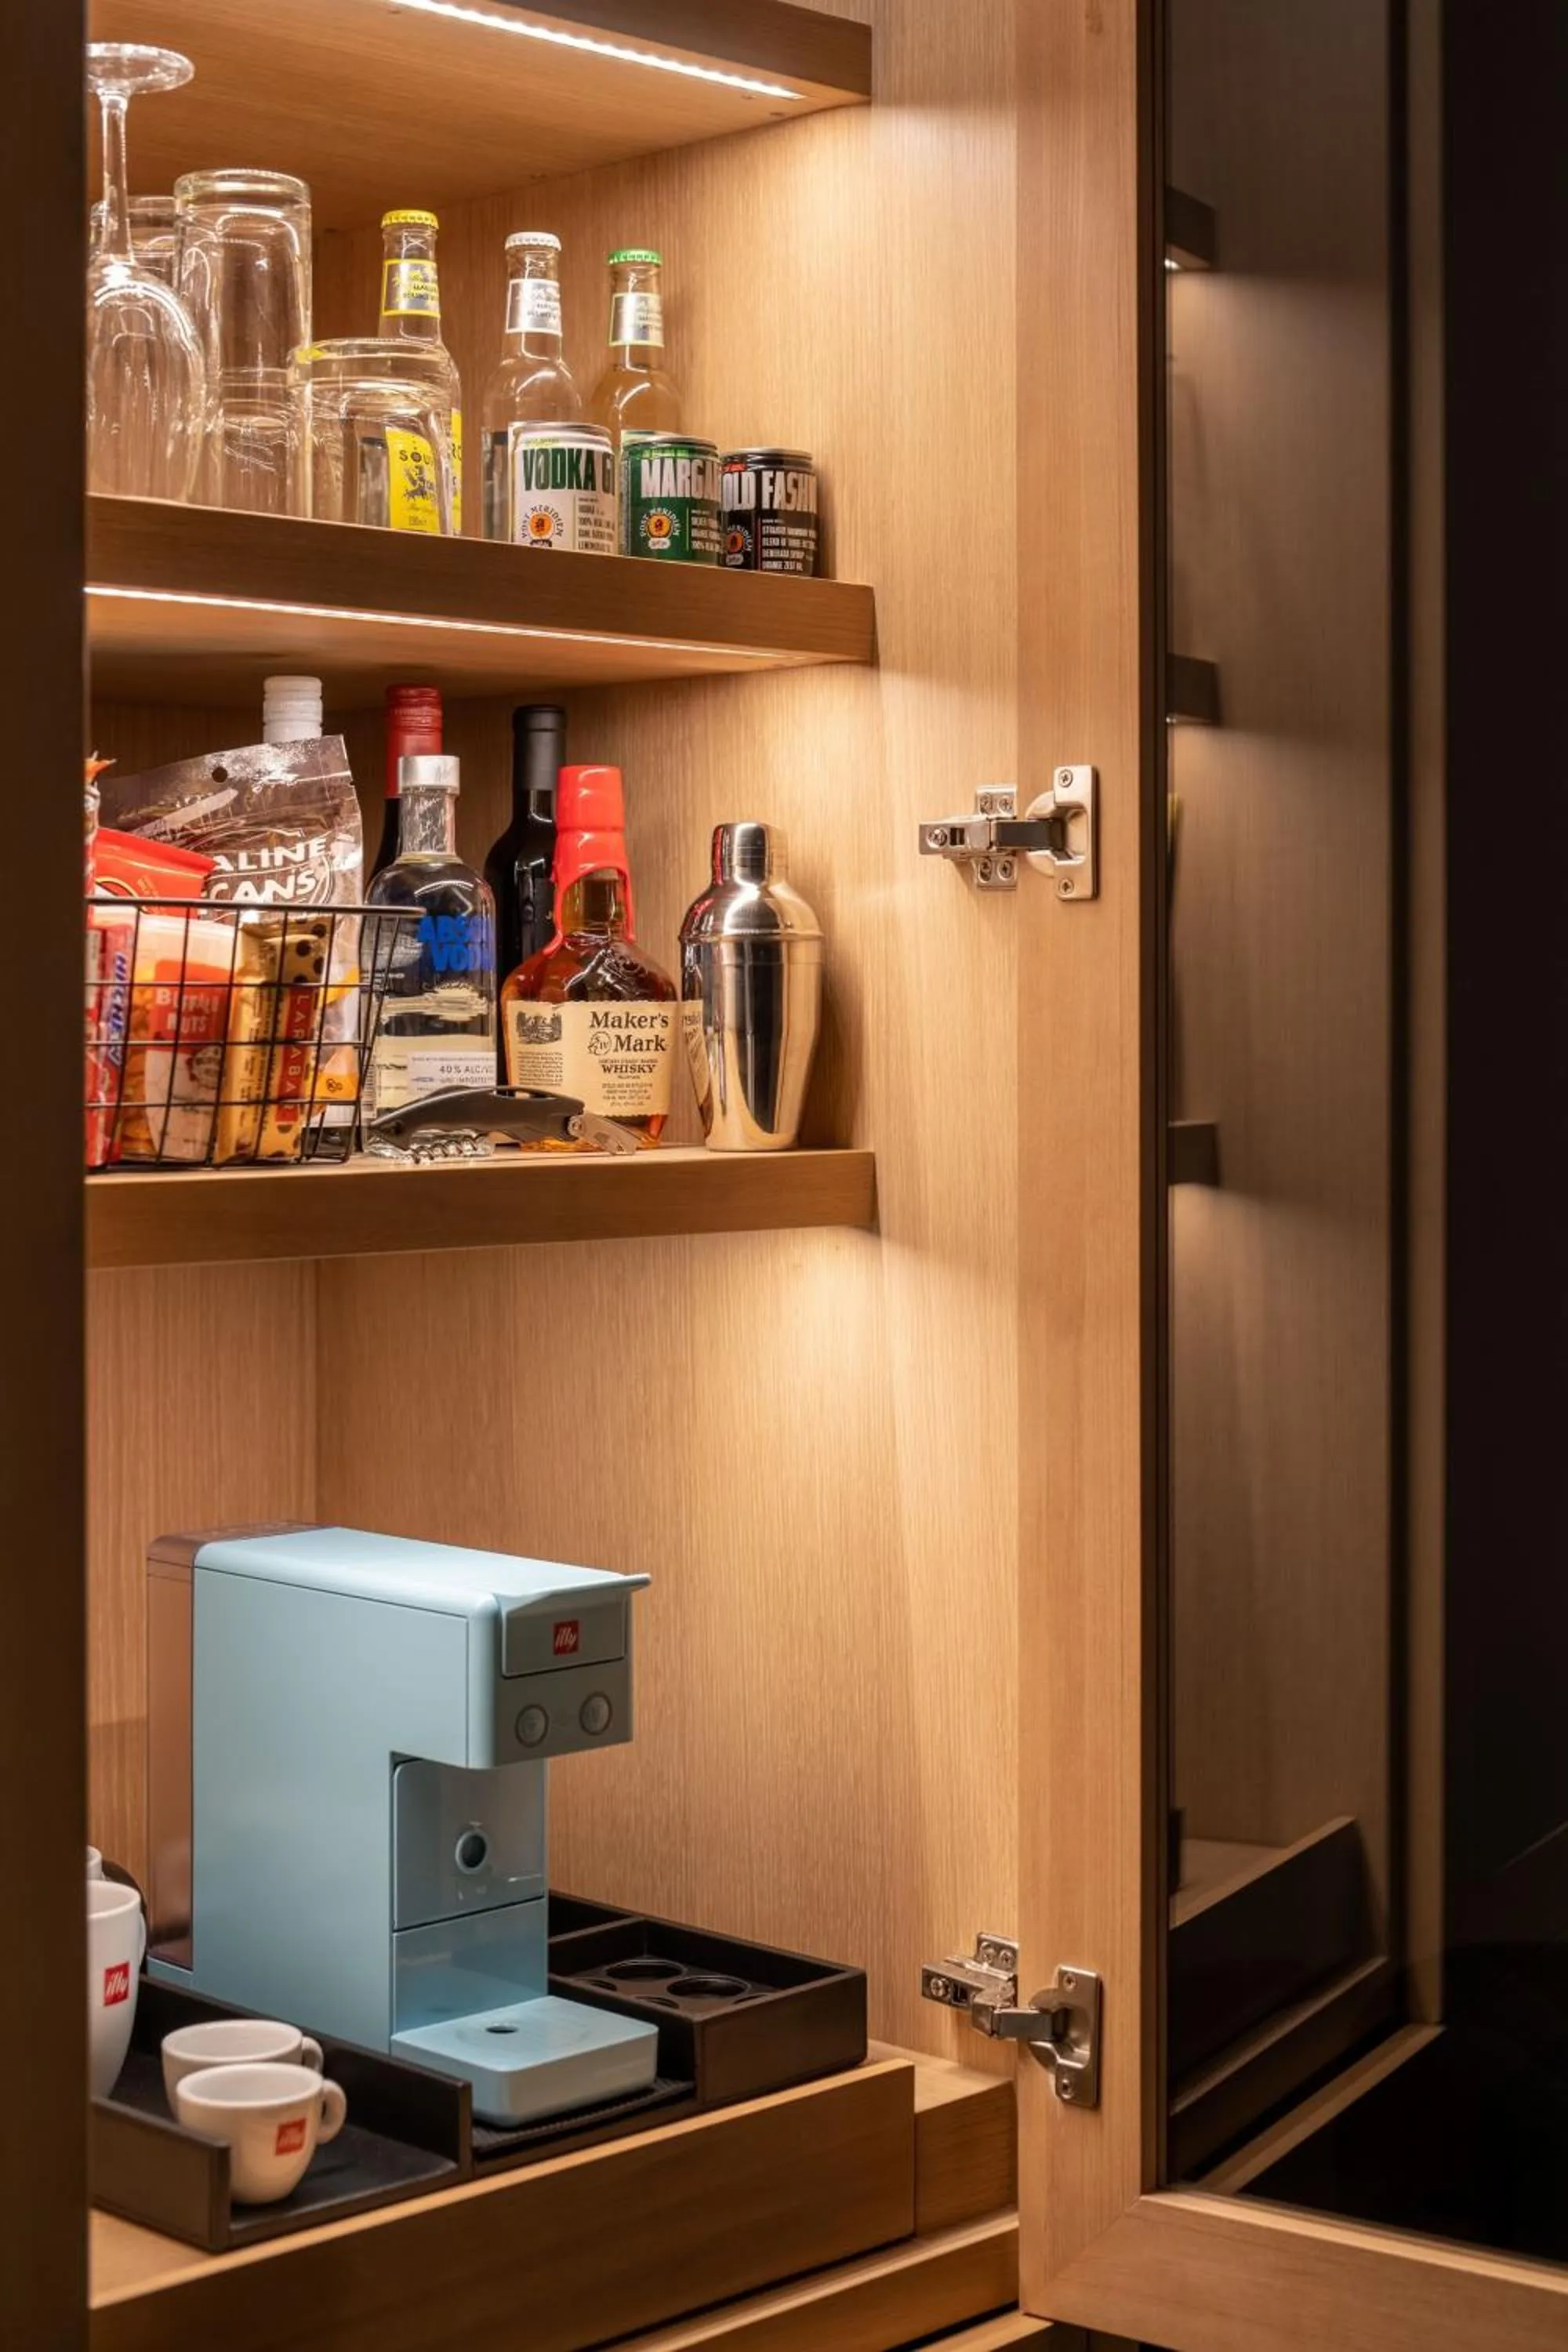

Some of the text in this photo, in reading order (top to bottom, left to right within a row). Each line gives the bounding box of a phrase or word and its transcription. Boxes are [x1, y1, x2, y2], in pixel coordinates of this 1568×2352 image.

[523, 448, 597, 492] VODKA
[723, 470, 757, 512] OLD
[590, 1011, 669, 1029] Maker's
[613, 1034, 667, 1052] Mark
[601, 1064, 656, 1074] WHISKY
[554, 1627, 577, 1652] illy
[106, 1969, 129, 1998] illy
